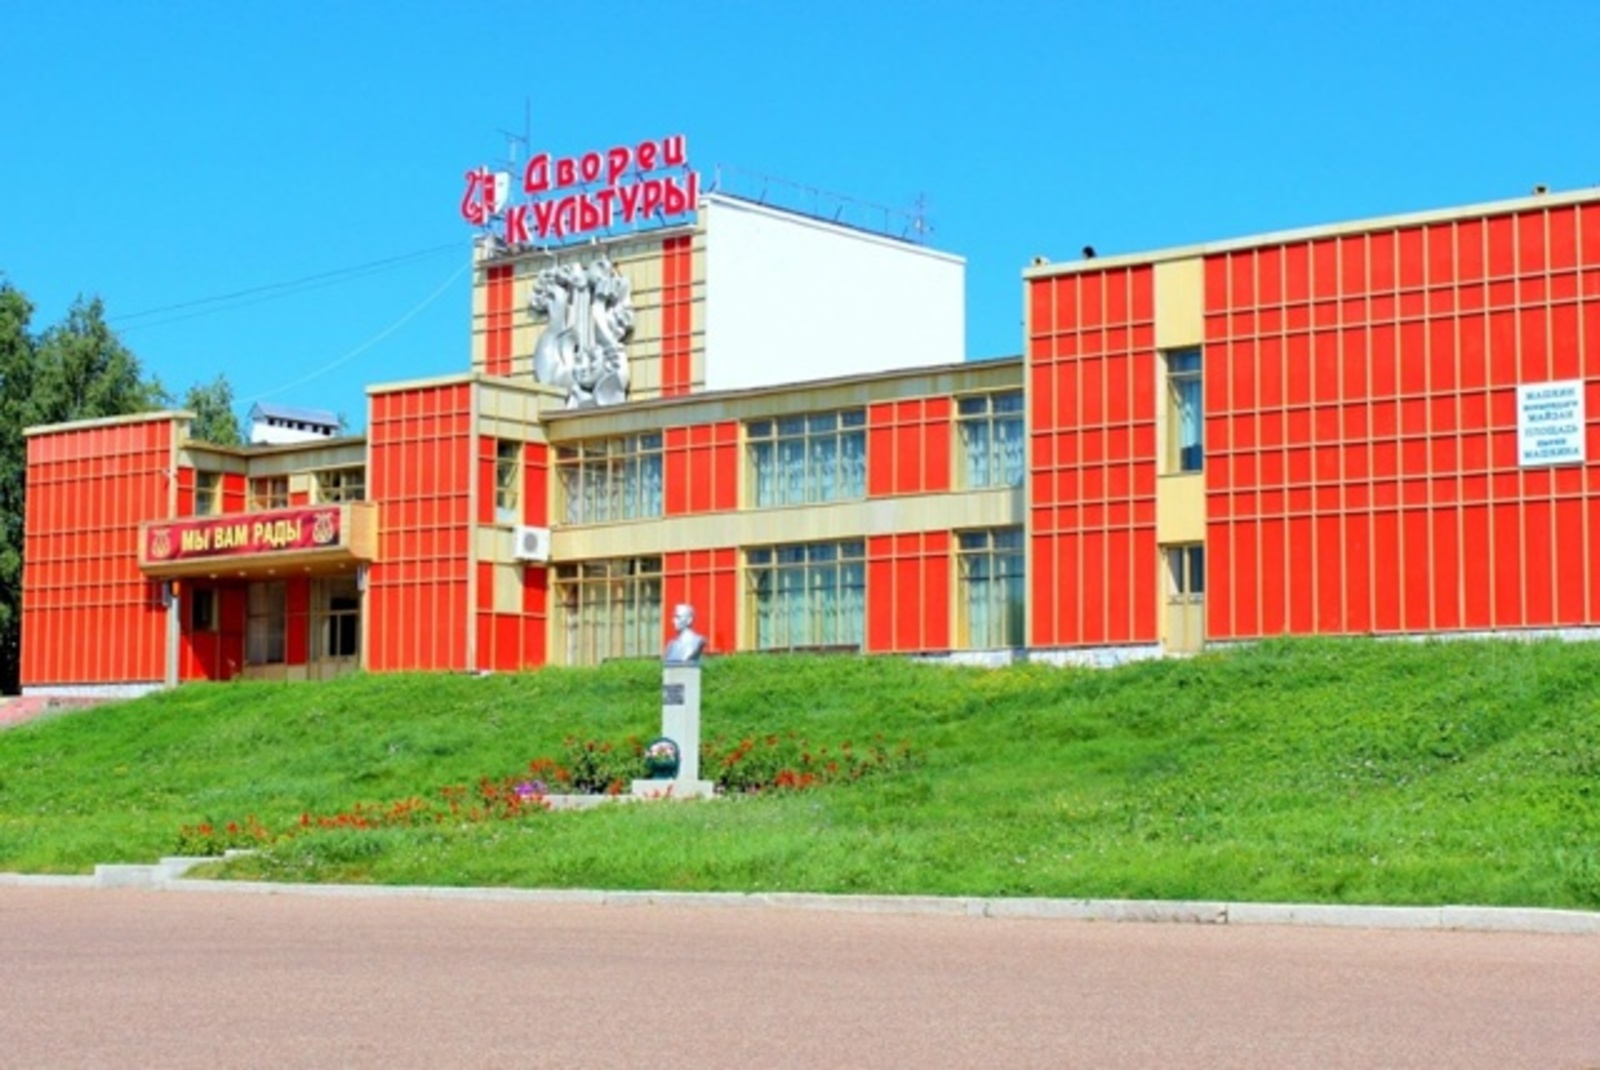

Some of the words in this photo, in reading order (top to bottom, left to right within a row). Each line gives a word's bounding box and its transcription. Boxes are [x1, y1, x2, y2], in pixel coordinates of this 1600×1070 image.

[504, 172, 698, 244] КУЛЬТУРЫ
[181, 528, 209, 551] МЫ
[214, 524, 248, 548] ВАМ
[253, 518, 302, 546] РАДЫ
